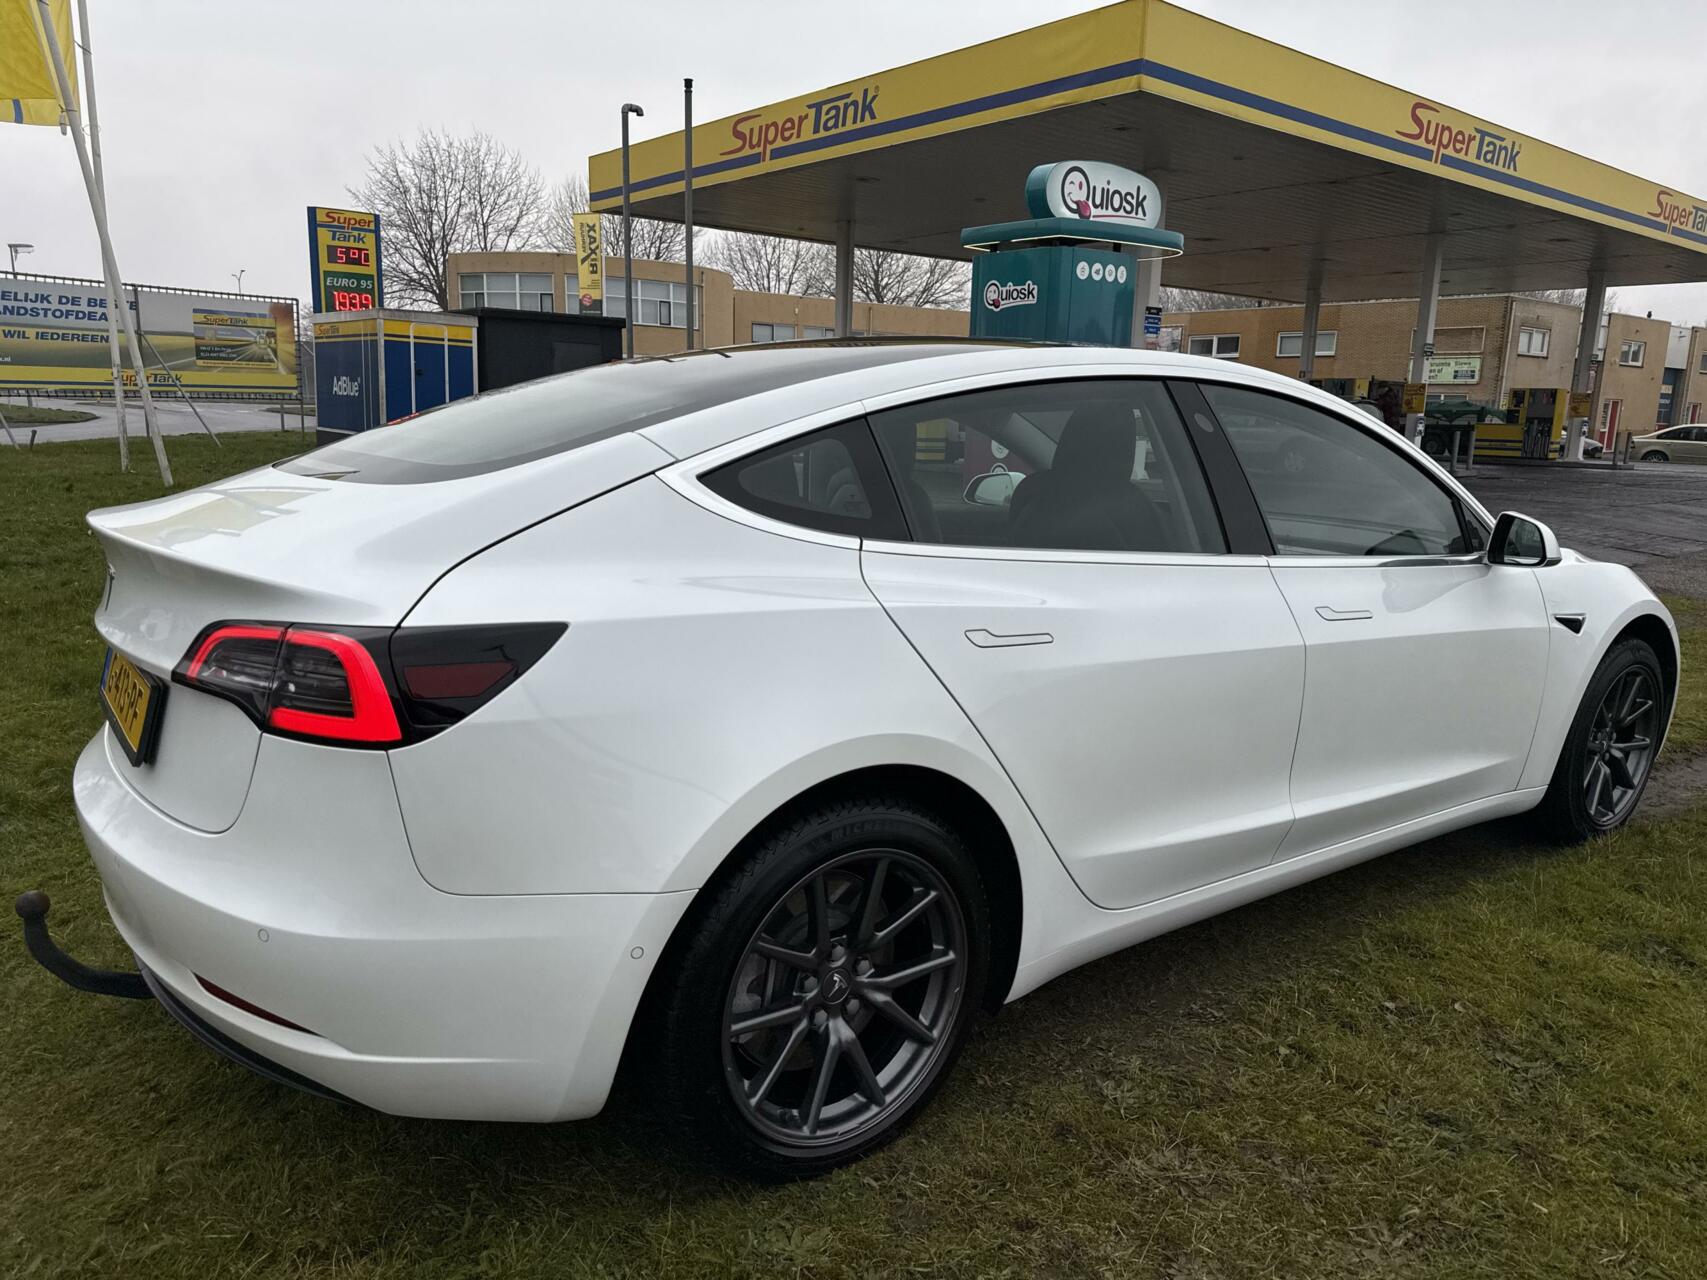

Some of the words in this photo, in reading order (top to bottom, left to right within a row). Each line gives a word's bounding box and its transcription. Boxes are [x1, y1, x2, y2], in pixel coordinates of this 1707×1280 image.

[1061, 166, 1147, 219] Quiosk
[320, 211, 373, 230] Super
[327, 230, 367, 244] Tank
[326, 277, 357, 288] EURO
[360, 281, 373, 289] 95
[0, 290, 52, 304] ELIJK
[58, 295, 81, 307] DE
[986, 282, 1036, 307] Quiosk
[2, 329, 30, 340] WIL
[36, 331, 110, 343] IEDEREEN
[332, 375, 359, 397] AdBlue
